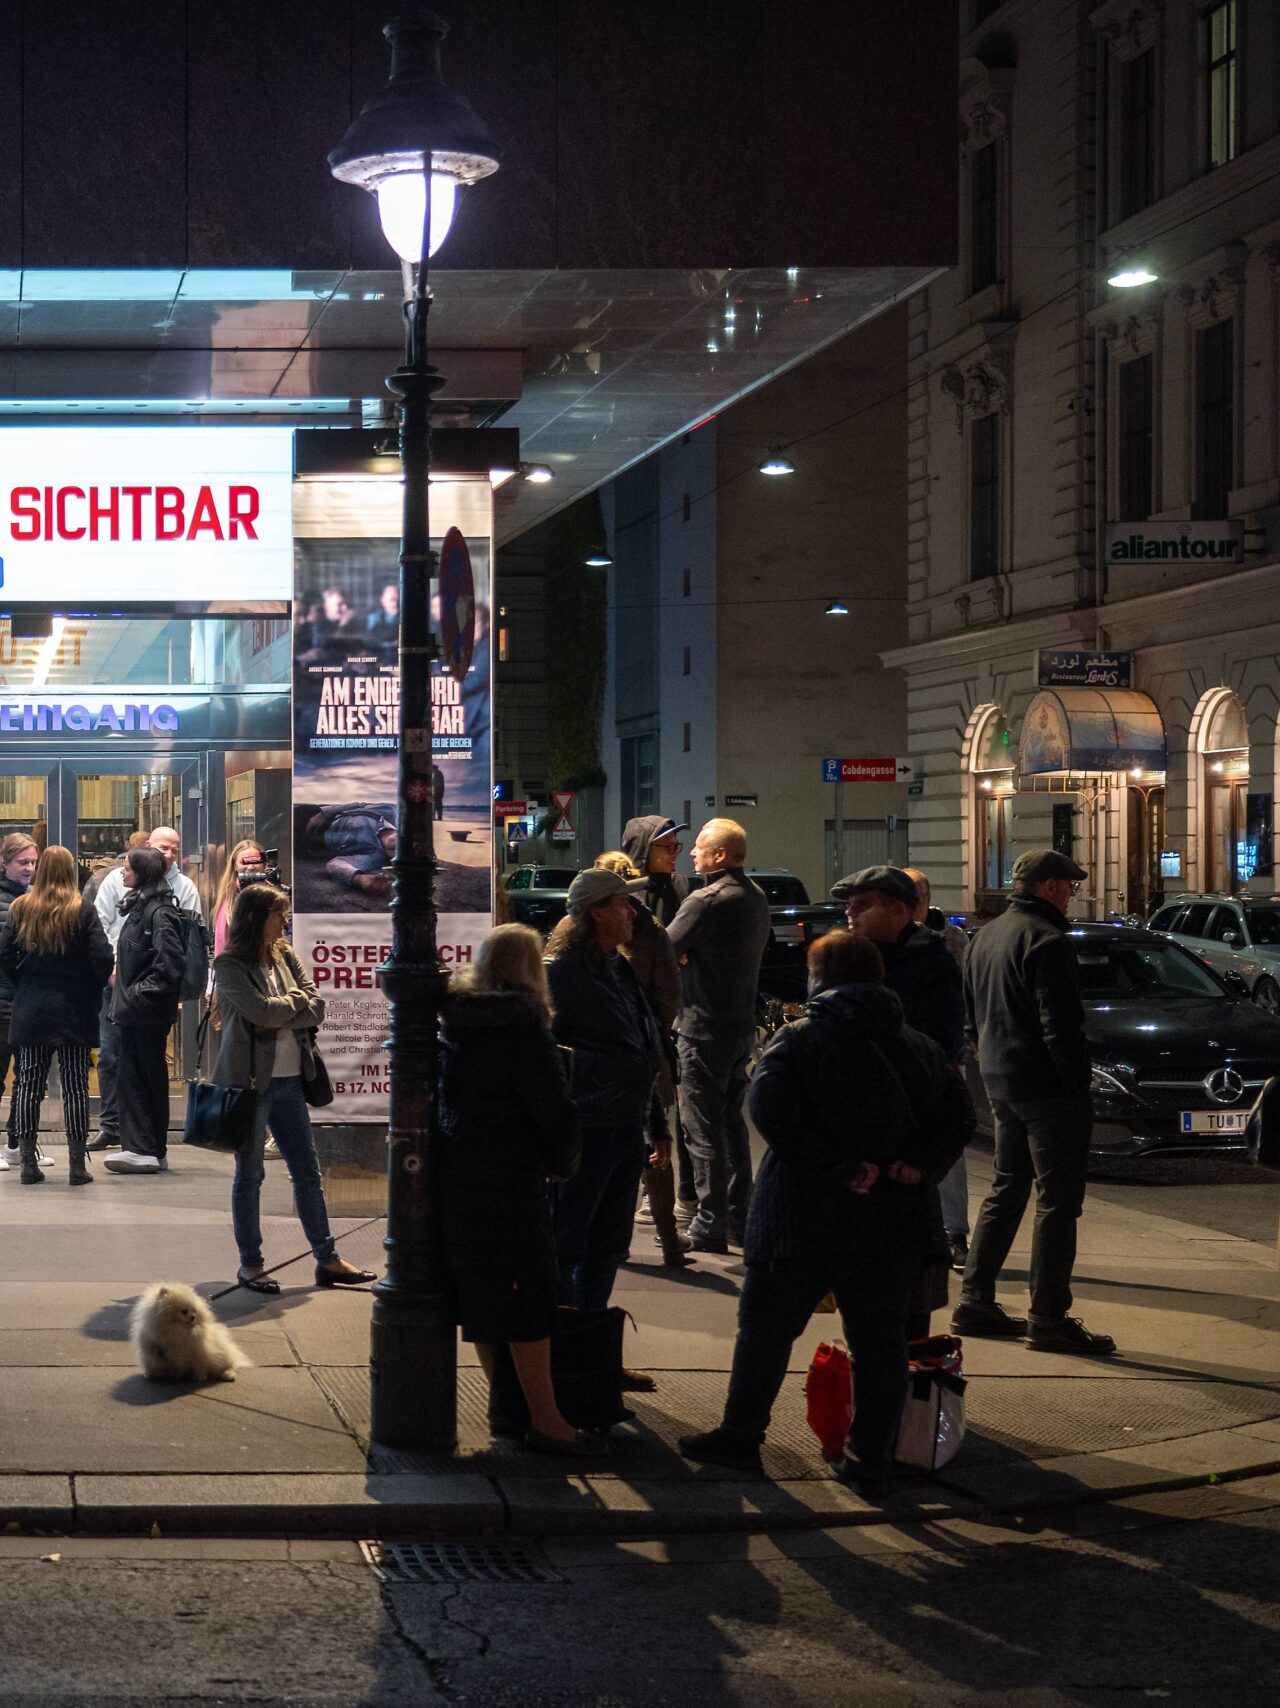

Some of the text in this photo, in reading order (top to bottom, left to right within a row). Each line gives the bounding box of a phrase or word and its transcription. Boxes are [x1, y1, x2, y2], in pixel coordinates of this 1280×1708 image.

[10, 486, 260, 541] SICHTBAR
[1111, 535, 1238, 559] aliantour
[320, 677, 350, 705] AM
[431, 677, 460, 705] IRD
[0, 704, 179, 731] EINGANG
[316, 706, 370, 734] ALLES
[842, 764, 894, 776] Cobdengasse
[326, 1012, 354, 1020] Harald
[362, 1065, 379, 1076] IM
[350, 1082, 367, 1093] 17.
[1207, 1114, 1250, 1128] TU T
